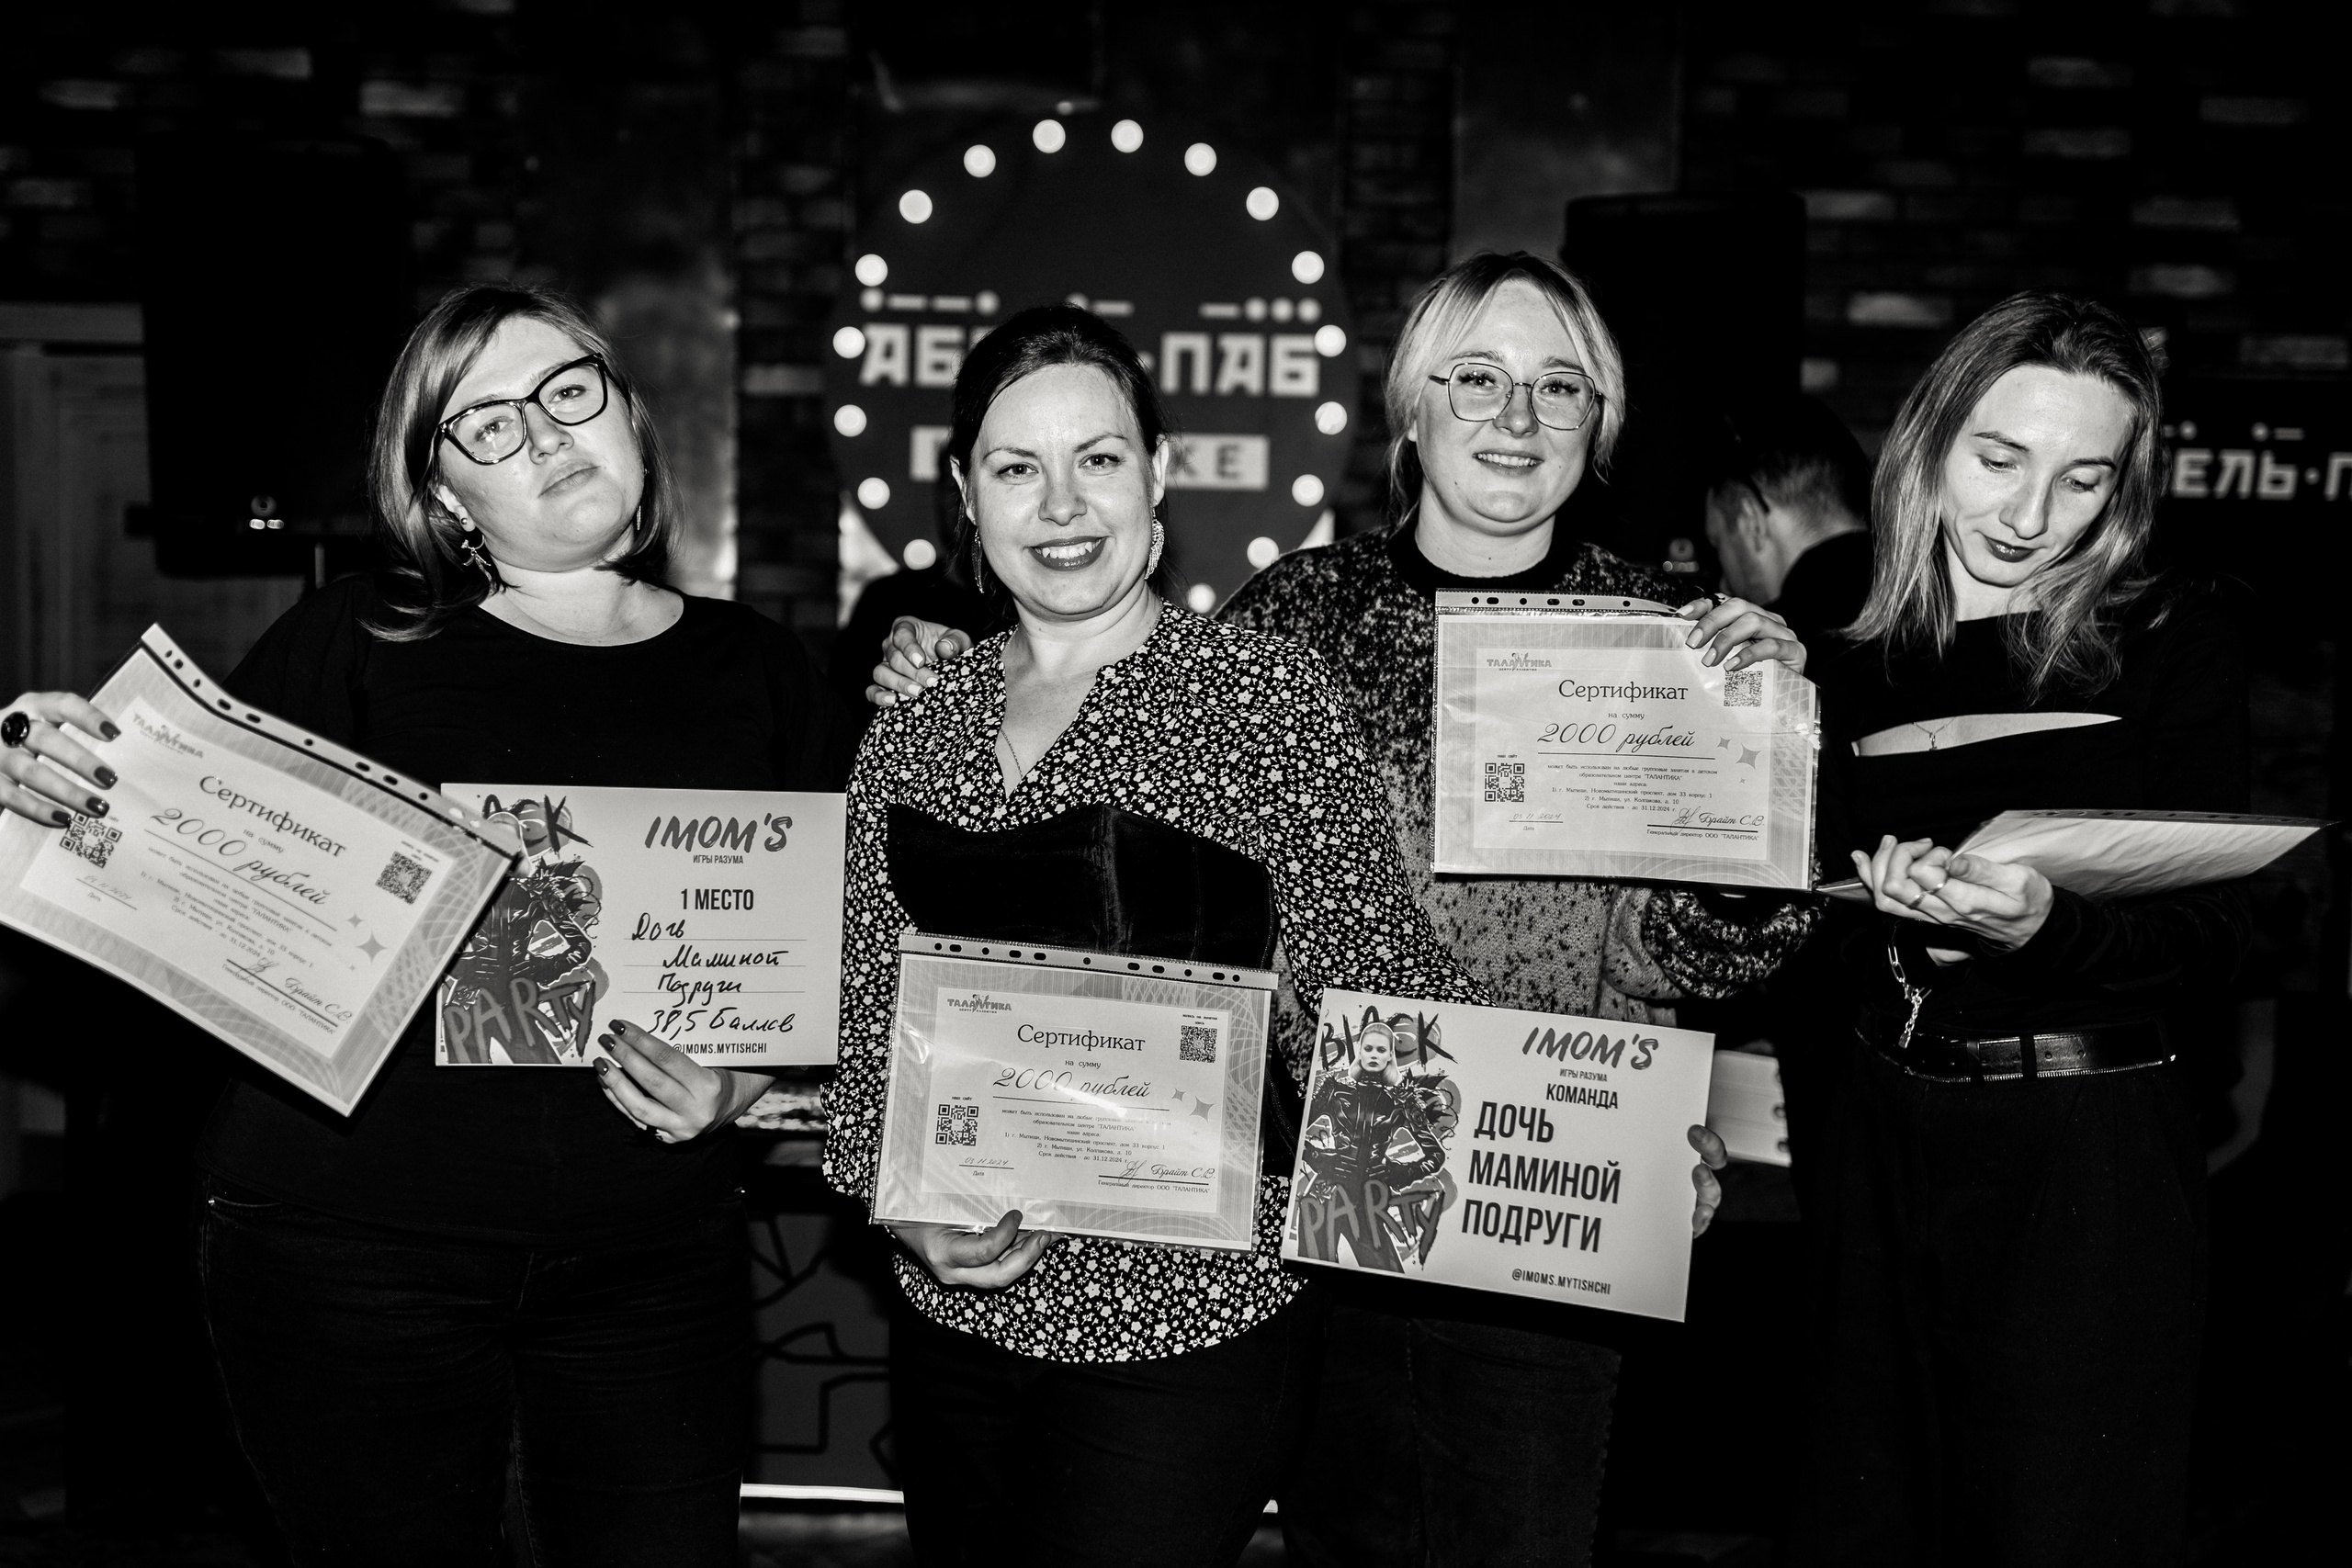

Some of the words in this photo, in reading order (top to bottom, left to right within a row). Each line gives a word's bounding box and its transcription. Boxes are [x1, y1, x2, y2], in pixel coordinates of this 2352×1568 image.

[1558, 679, 1689, 703] Сертификат
[1622, 713, 1645, 721] сумму
[1536, 722, 1616, 744] 2000
[1615, 726, 1695, 752] рублей
[198, 775, 345, 857] Сертификат
[1698, 812, 1737, 827] Брайт
[243, 829, 254, 839] на
[257, 837, 284, 853] сумму
[644, 813, 793, 853] IMOM'S
[151, 808, 246, 856] 2000
[232, 860, 331, 905] рублей
[693, 855, 712, 864] ИГРЫ
[714, 855, 743, 864] РАЗУМА
[681, 889, 688, 910] 1
[695, 889, 754, 910] МЕСТО
[444, 977, 595, 1064] PARTY
[648, 1010, 707, 1041] 38,5
[1017, 1023, 1146, 1052] Сертификат
[1521, 1026, 1659, 1071] IMOM'S
[992, 1067, 1073, 1090] 2000
[1078, 1061, 1102, 1070] сумму
[1559, 1068, 1578, 1078] ИГРЫ
[1578, 1070, 1608, 1082] РАЗУМА
[1545, 1082, 1618, 1110] КОМАНДА
[1473, 1100, 1555, 1144] ДОЧЬ
[1092, 1155, 1122, 1163] 31.12.2024
[1150, 1163, 1189, 1179] Брайт
[1468, 1149, 1622, 1204] МАМИНОЙ
[1300, 1180, 1446, 1270] PARTY
[1461, 1198, 1601, 1253] ПОДРУГИ
[1511, 1268, 1611, 1295] @IMOMS.MYTISHCHI
